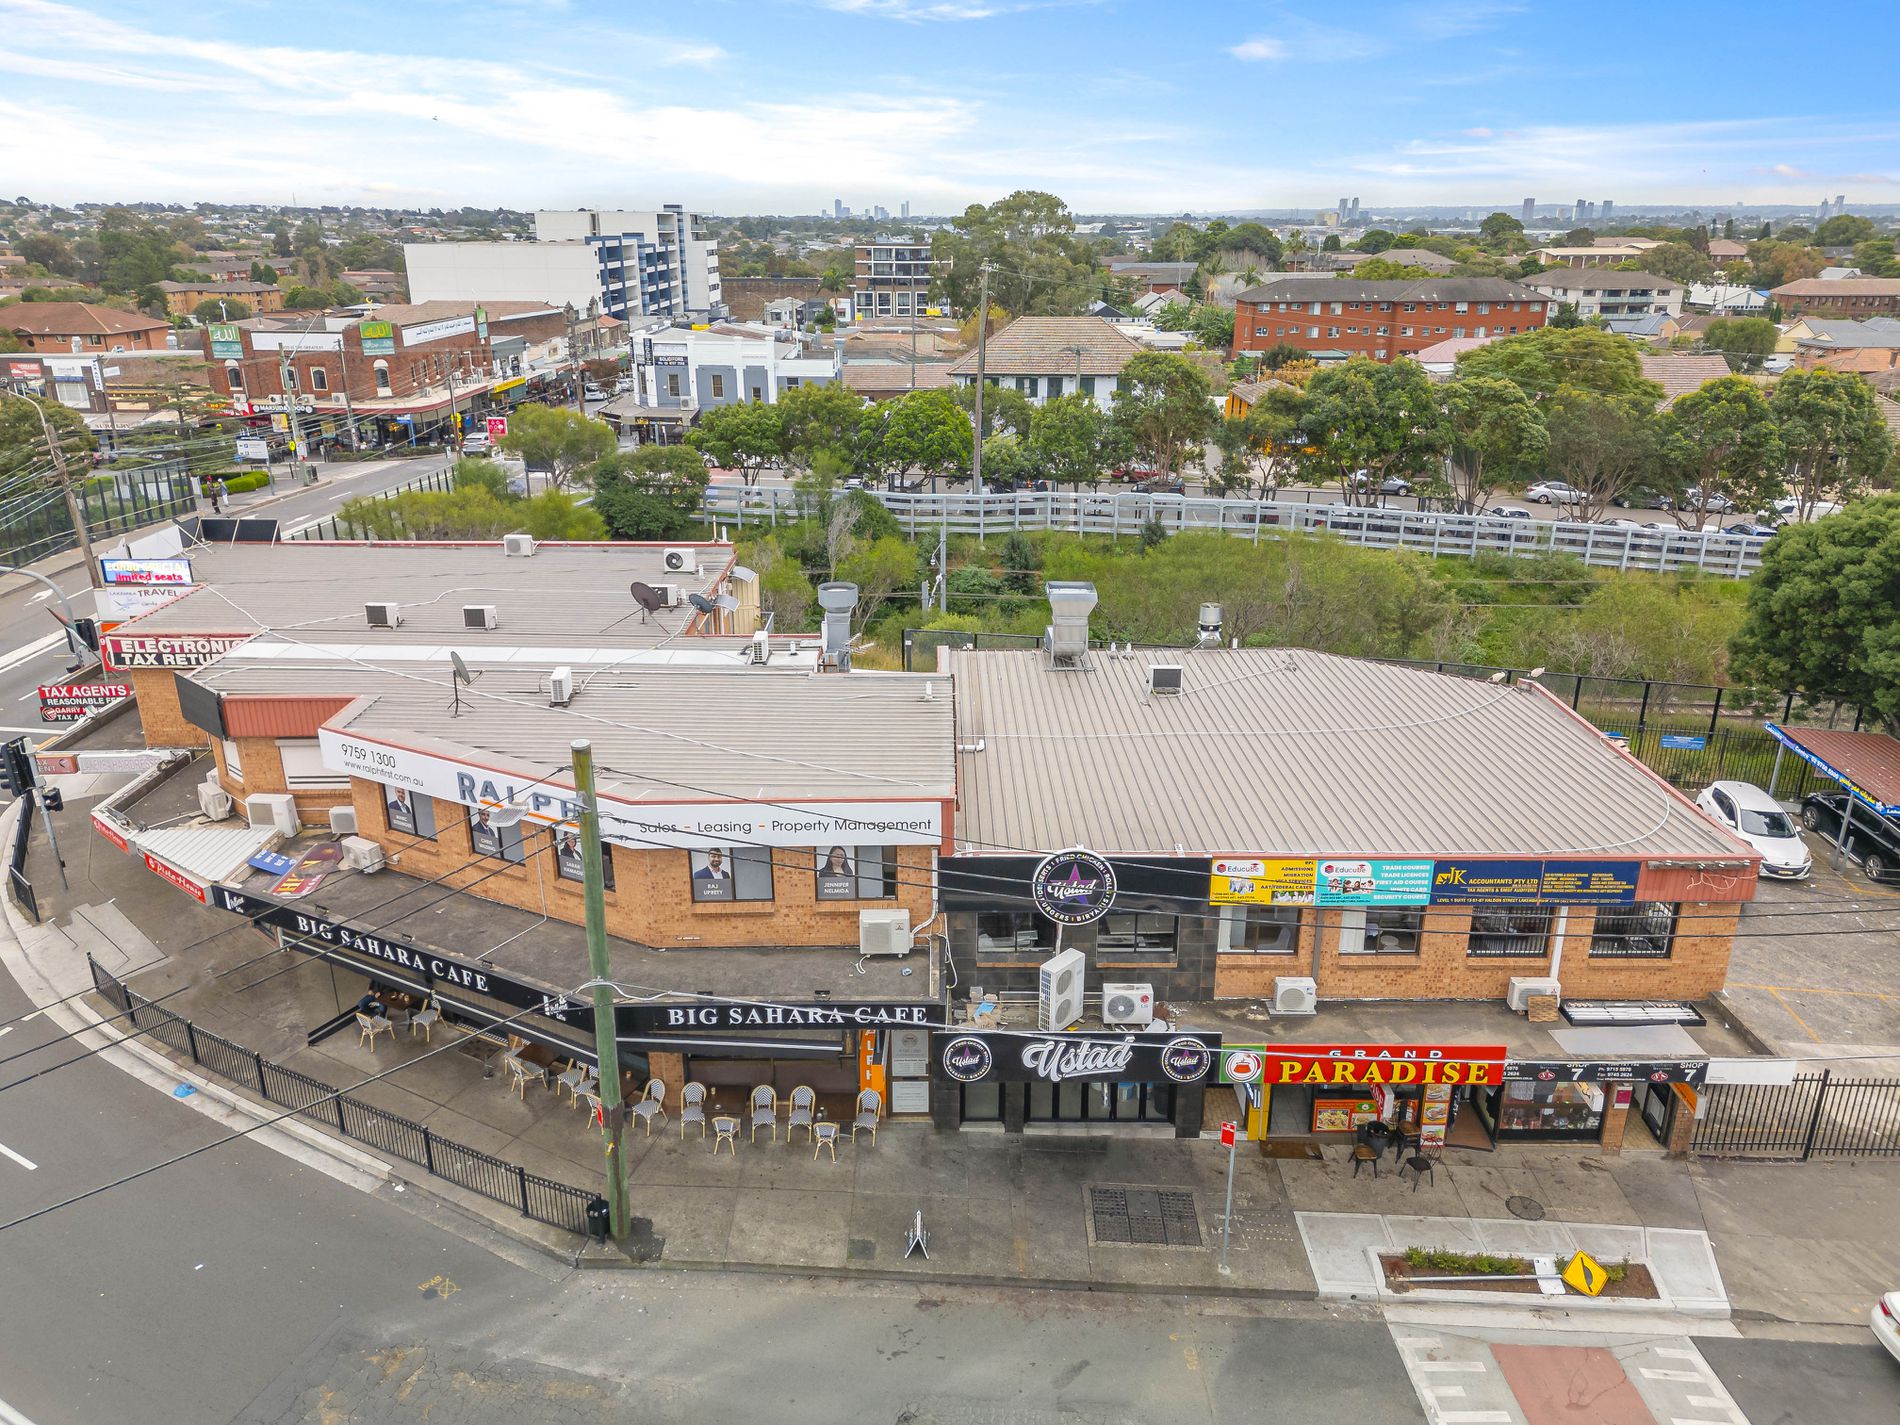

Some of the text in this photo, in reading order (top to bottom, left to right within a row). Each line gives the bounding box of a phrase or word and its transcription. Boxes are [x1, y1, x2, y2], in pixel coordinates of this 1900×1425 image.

[154, 573, 183, 581] seats
[137, 588, 178, 598] TRAVEL
[121, 653, 156, 666] TAX
[42, 685, 128, 698] TAX AGENTS
[46, 698, 105, 706] REASONABLE
[341, 744, 396, 768] 9759 1300
[344, 760, 424, 787] www.ralphfirst.com.au
[640, 819, 932, 834] Sales Leasing Property Management
[1055, 853, 1076, 864] FRIED
[296, 916, 488, 992] BIG SAHARA CAFE
[668, 1007, 929, 1026] BIG SAHARA CAFE
[1022, 1035, 1136, 1082] Ustad
[1329, 1050, 1443, 1059] GRAND
[1279, 1062, 1490, 1084] PARADISE
[1571, 1068, 1584, 1081] 7
[1684, 1069, 1696, 1082] 7
